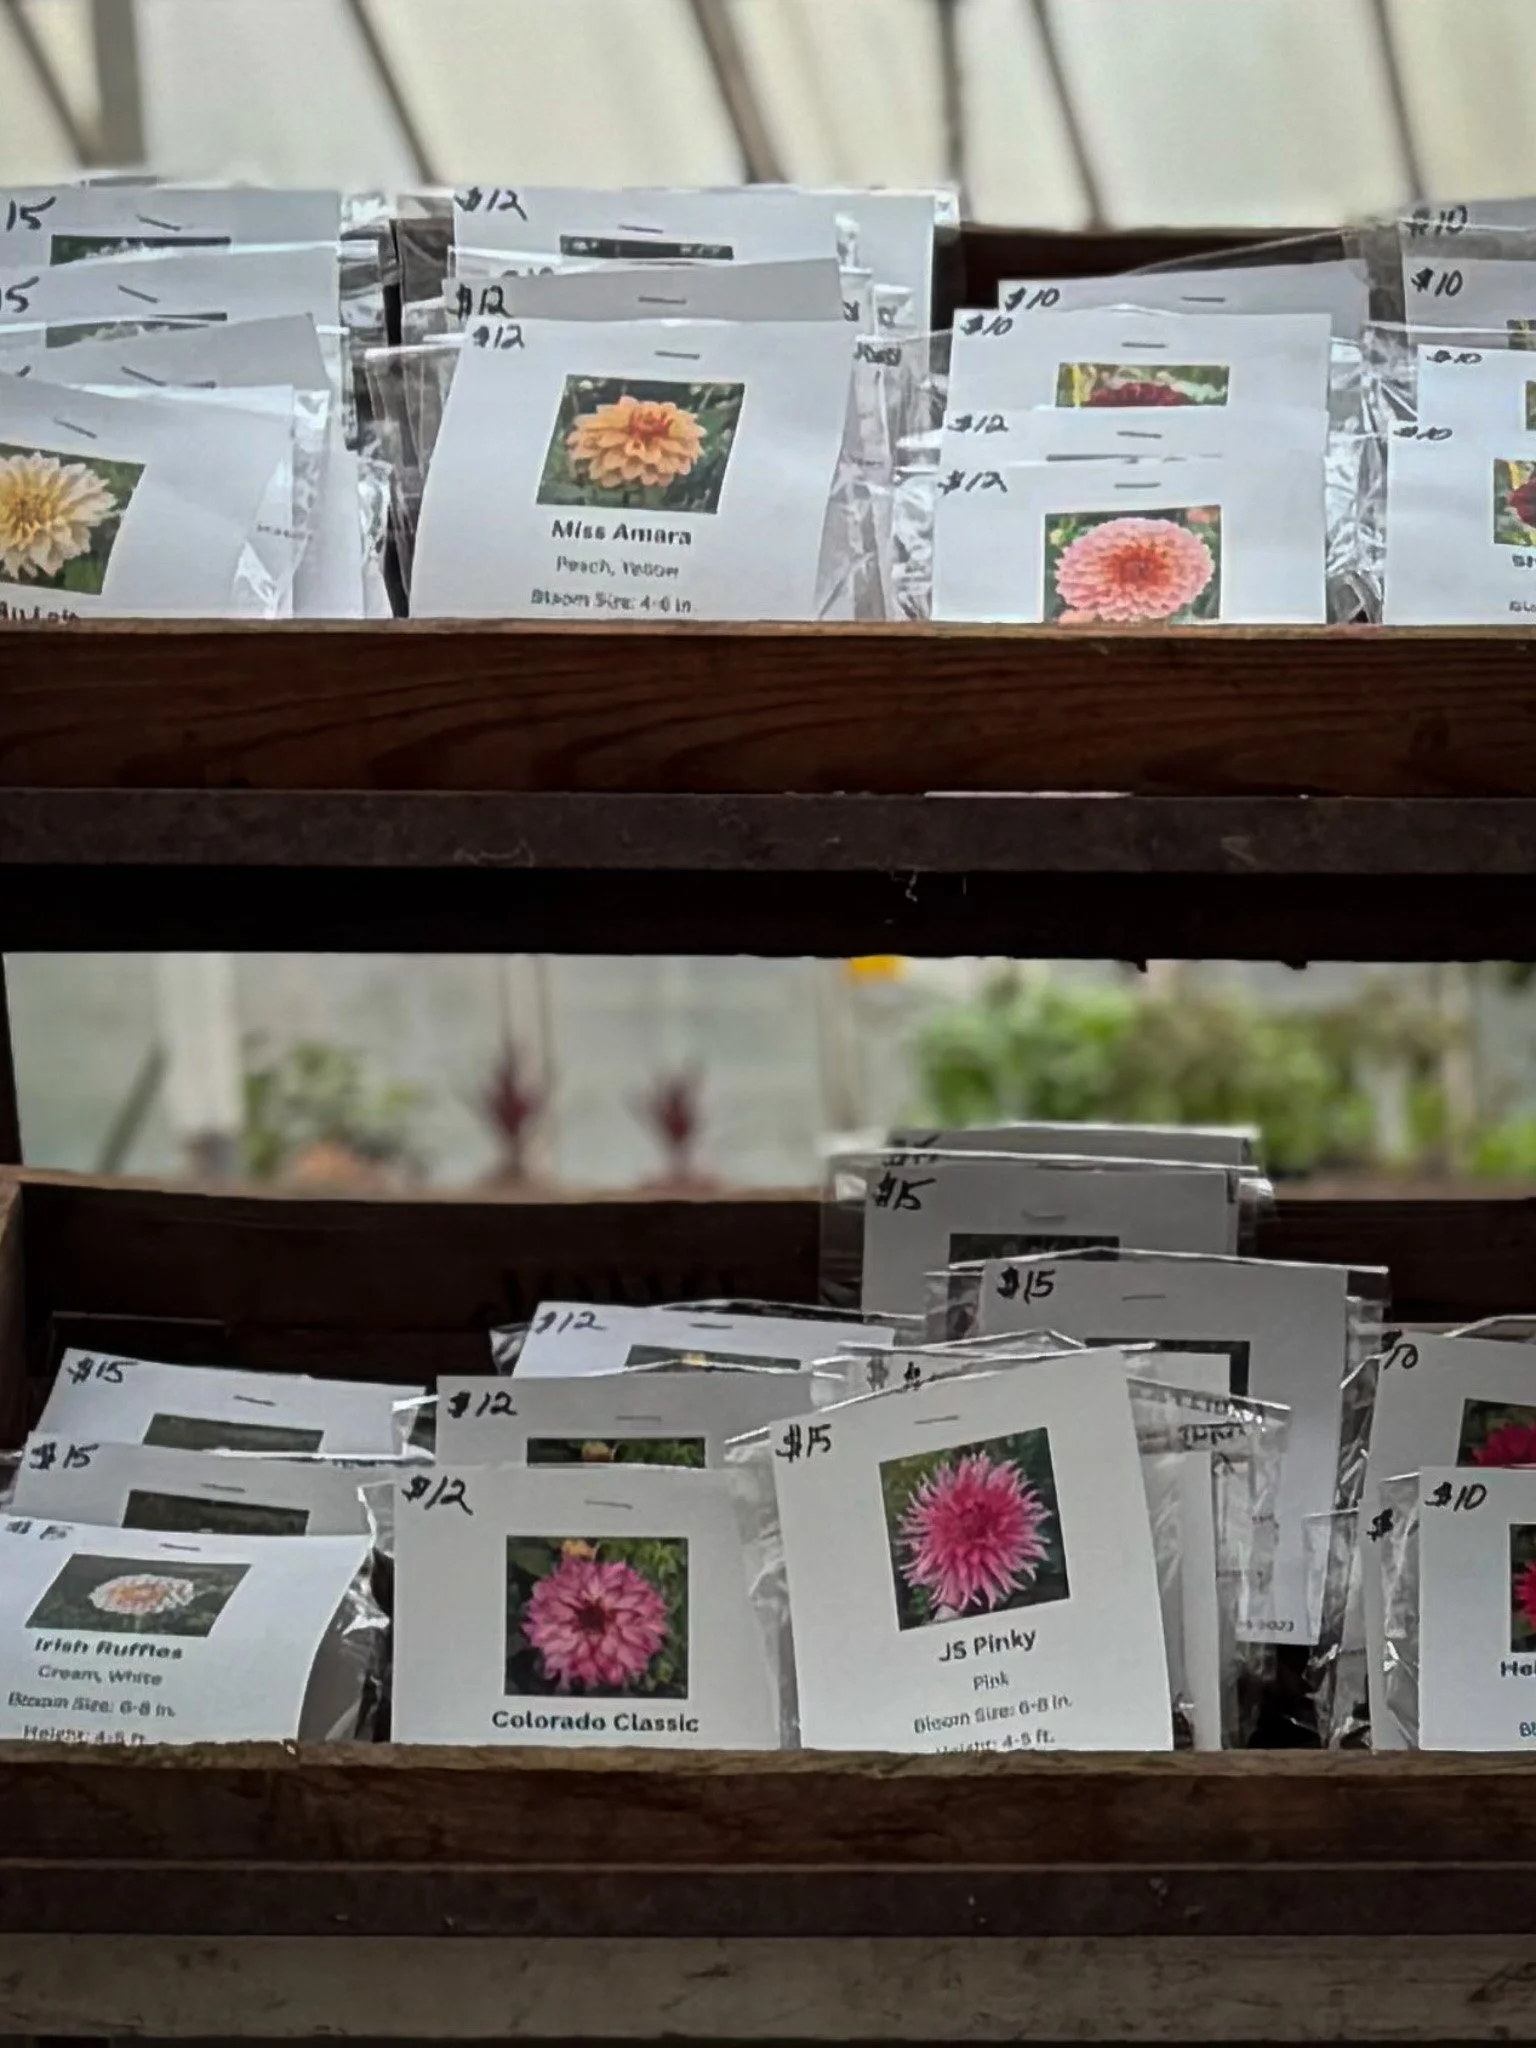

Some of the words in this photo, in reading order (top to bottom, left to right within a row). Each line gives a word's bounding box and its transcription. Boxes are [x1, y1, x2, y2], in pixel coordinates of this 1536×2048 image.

[6, 196, 57, 232] 15
[453, 187, 528, 221] $12
[0, 276, 39, 313] 5
[1411, 267, 1464, 297] $10
[447, 283, 514, 322] $12
[1005, 286, 1061, 312] $10
[472, 324, 525, 350] $12
[960, 314, 1014, 336] $10
[949, 414, 1009, 434] $12
[937, 469, 1008, 495] $12
[551, 519, 606, 540] Miss
[612, 523, 692, 546] Amara
[556, 555, 615, 577] Peach,
[531, 588, 590, 608] Bloom
[873, 1171, 937, 1211] $15
[996, 1266, 1056, 1304] $15
[537, 1310, 606, 1333] $12
[66, 1356, 140, 1385] $15
[447, 1390, 518, 1420] $12
[28, 1441, 100, 1470] $15
[775, 1423, 832, 1464] $15
[402, 1476, 473, 1515] $12
[1424, 1481, 1488, 1512] $10
[35, 1637, 89, 1654] Irish
[96, 1639, 183, 1660] Ruffles
[938, 1640, 968, 1662] JS
[973, 1628, 1036, 1656] Pinky
[38, 1665, 102, 1684] Cream,
[108, 1669, 163, 1686] White
[973, 1671, 1009, 1691] Pink
[1500, 1660, 1536, 1677] Ha
[8, 1691, 69, 1709] Bloom
[491, 1710, 606, 1731] Colorado
[613, 1712, 699, 1733] Classic
[913, 1711, 970, 1734] Bloom
[974, 1705, 1015, 1723] Size:
[1035, 1728, 1055, 1744] ft.
